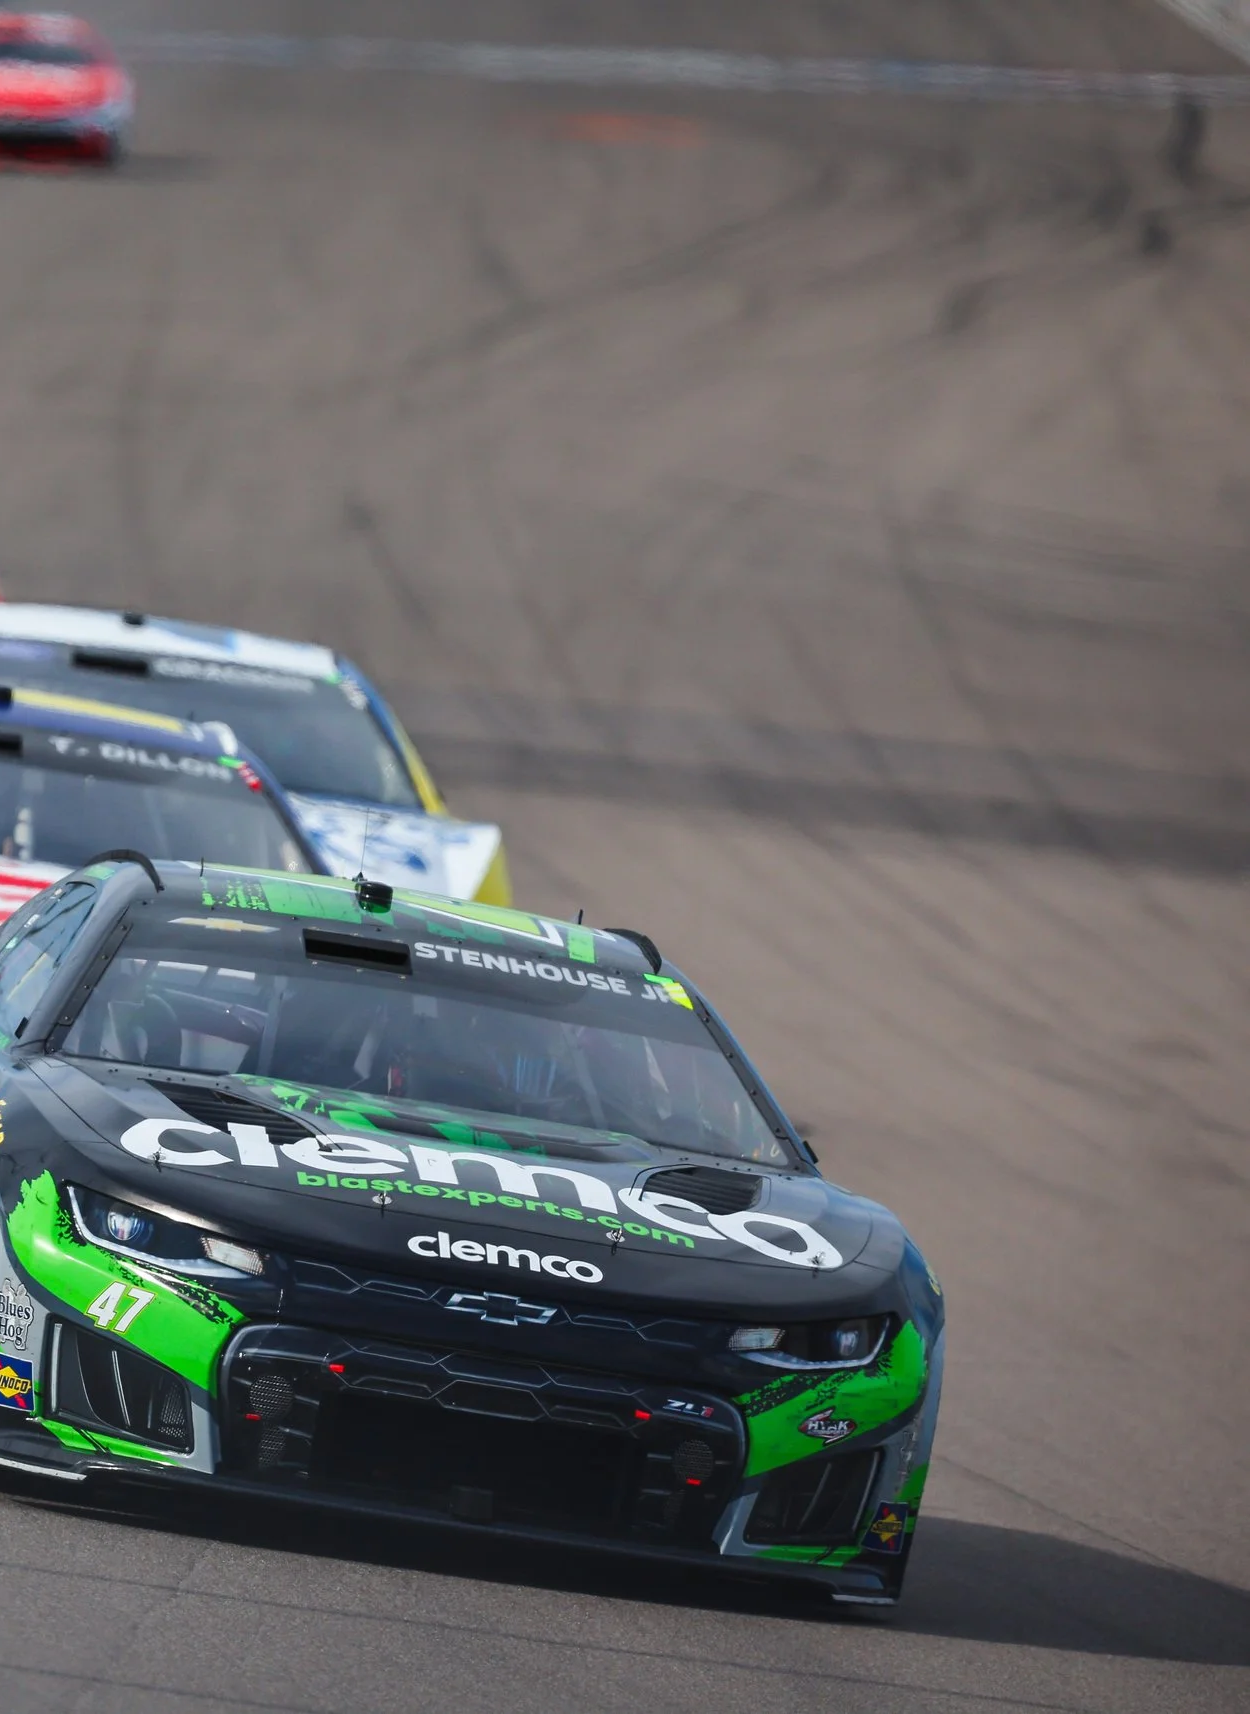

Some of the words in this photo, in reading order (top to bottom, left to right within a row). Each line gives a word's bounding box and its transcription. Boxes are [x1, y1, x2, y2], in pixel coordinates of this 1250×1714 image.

[49, 734, 88, 757] T.
[98, 740, 233, 782] DILLON
[414, 942, 632, 996] STENHOUSE
[120, 1118, 843, 1269] clemco
[297, 1172, 695, 1249] blastexperts.com
[407, 1231, 603, 1283] clemco
[85, 1281, 156, 1333] 47
